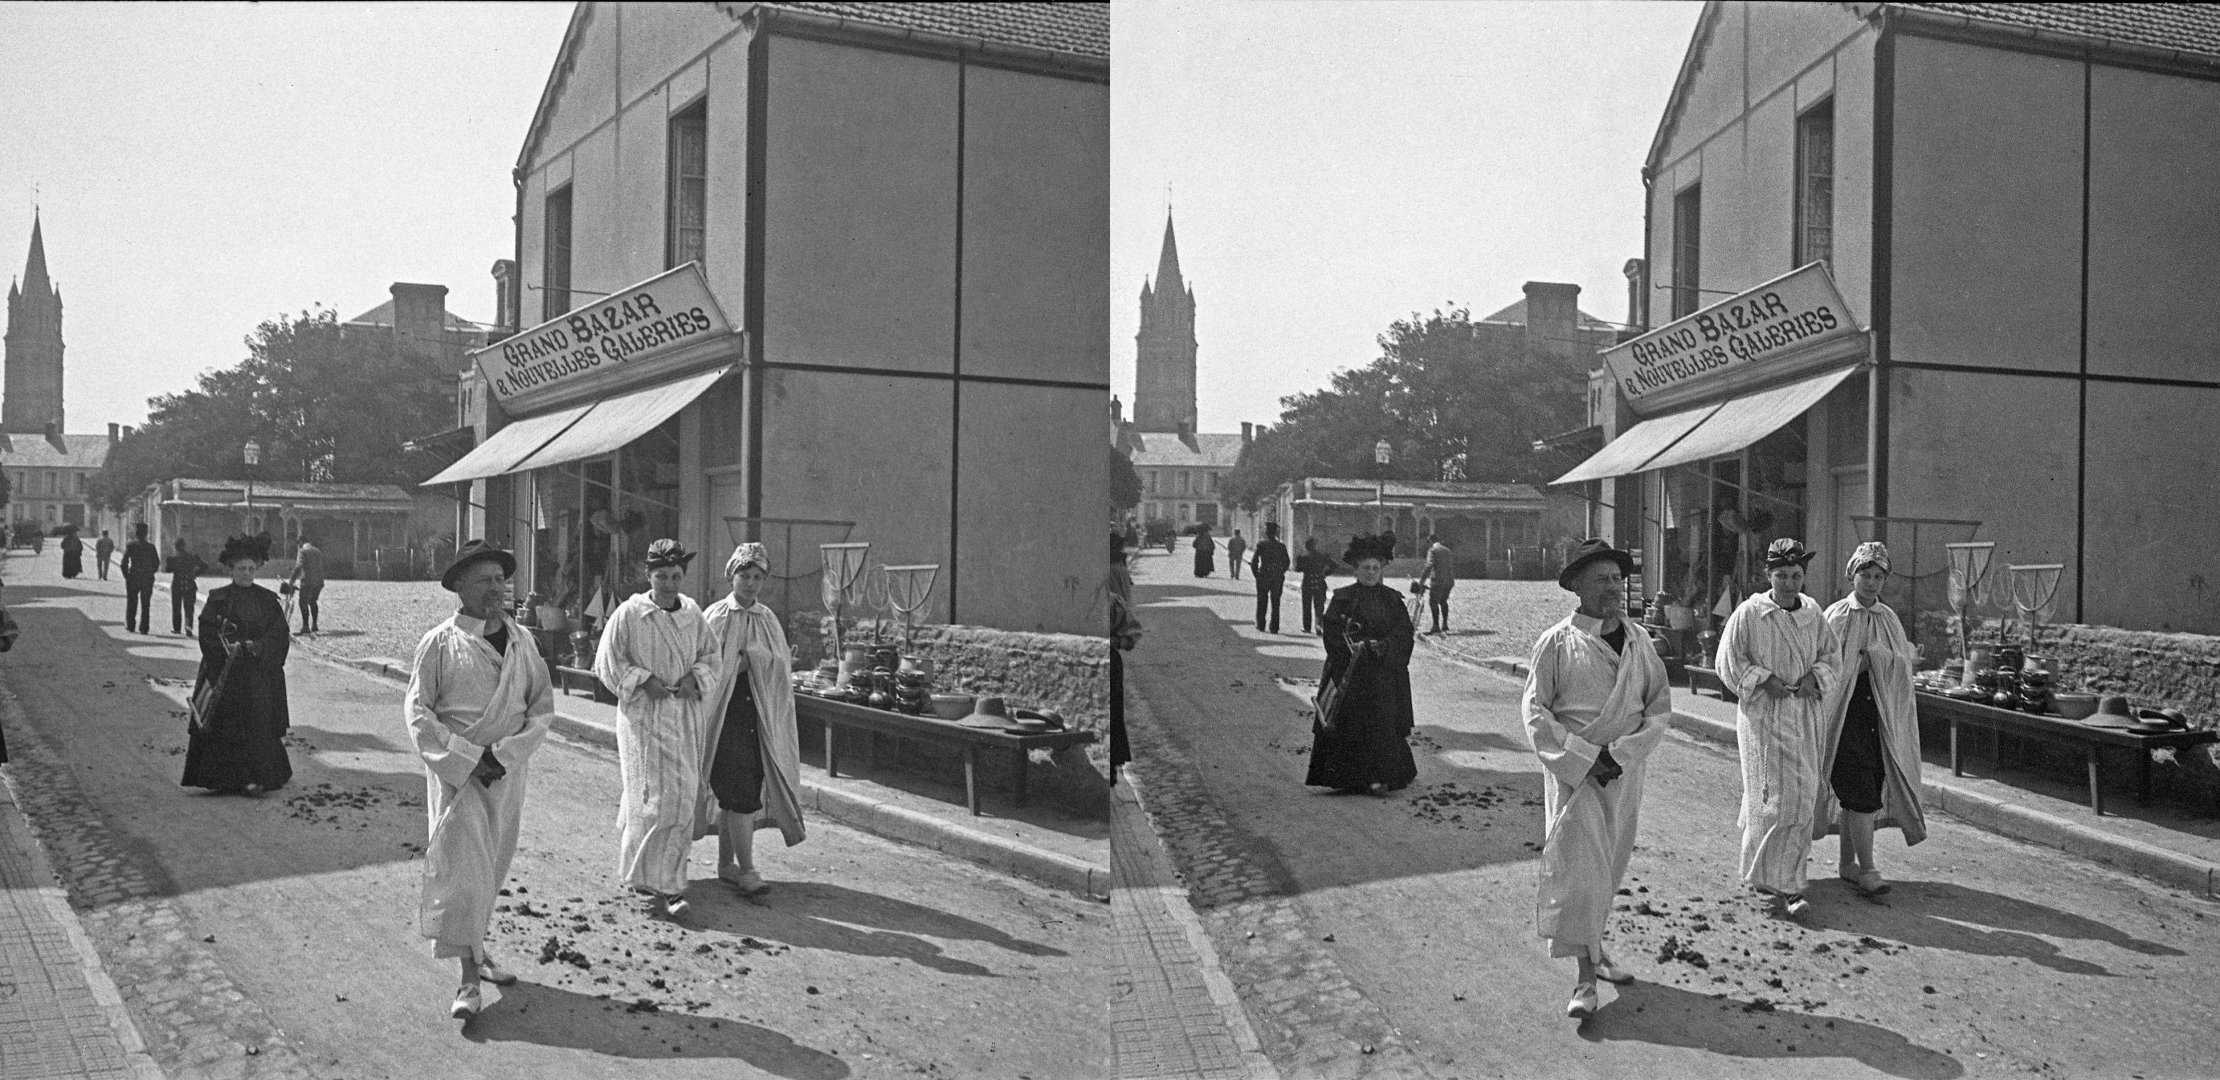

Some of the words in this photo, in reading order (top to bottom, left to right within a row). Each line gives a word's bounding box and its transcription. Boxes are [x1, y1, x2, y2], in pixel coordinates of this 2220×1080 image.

[496, 379, 513, 396] &
[505, 346, 601, 391] NOUVELLES
[600, 307, 711, 363] GALERIES
[503, 328, 569, 368] GRAND
[567, 293, 662, 343] BAZAR
[1625, 378, 1642, 395] &
[1634, 345, 1730, 390] NOUVELLES
[1728, 306, 1838, 362] GALERIES
[1631, 328, 1697, 367] GRAND
[1695, 292, 1789, 342] BAZAR
